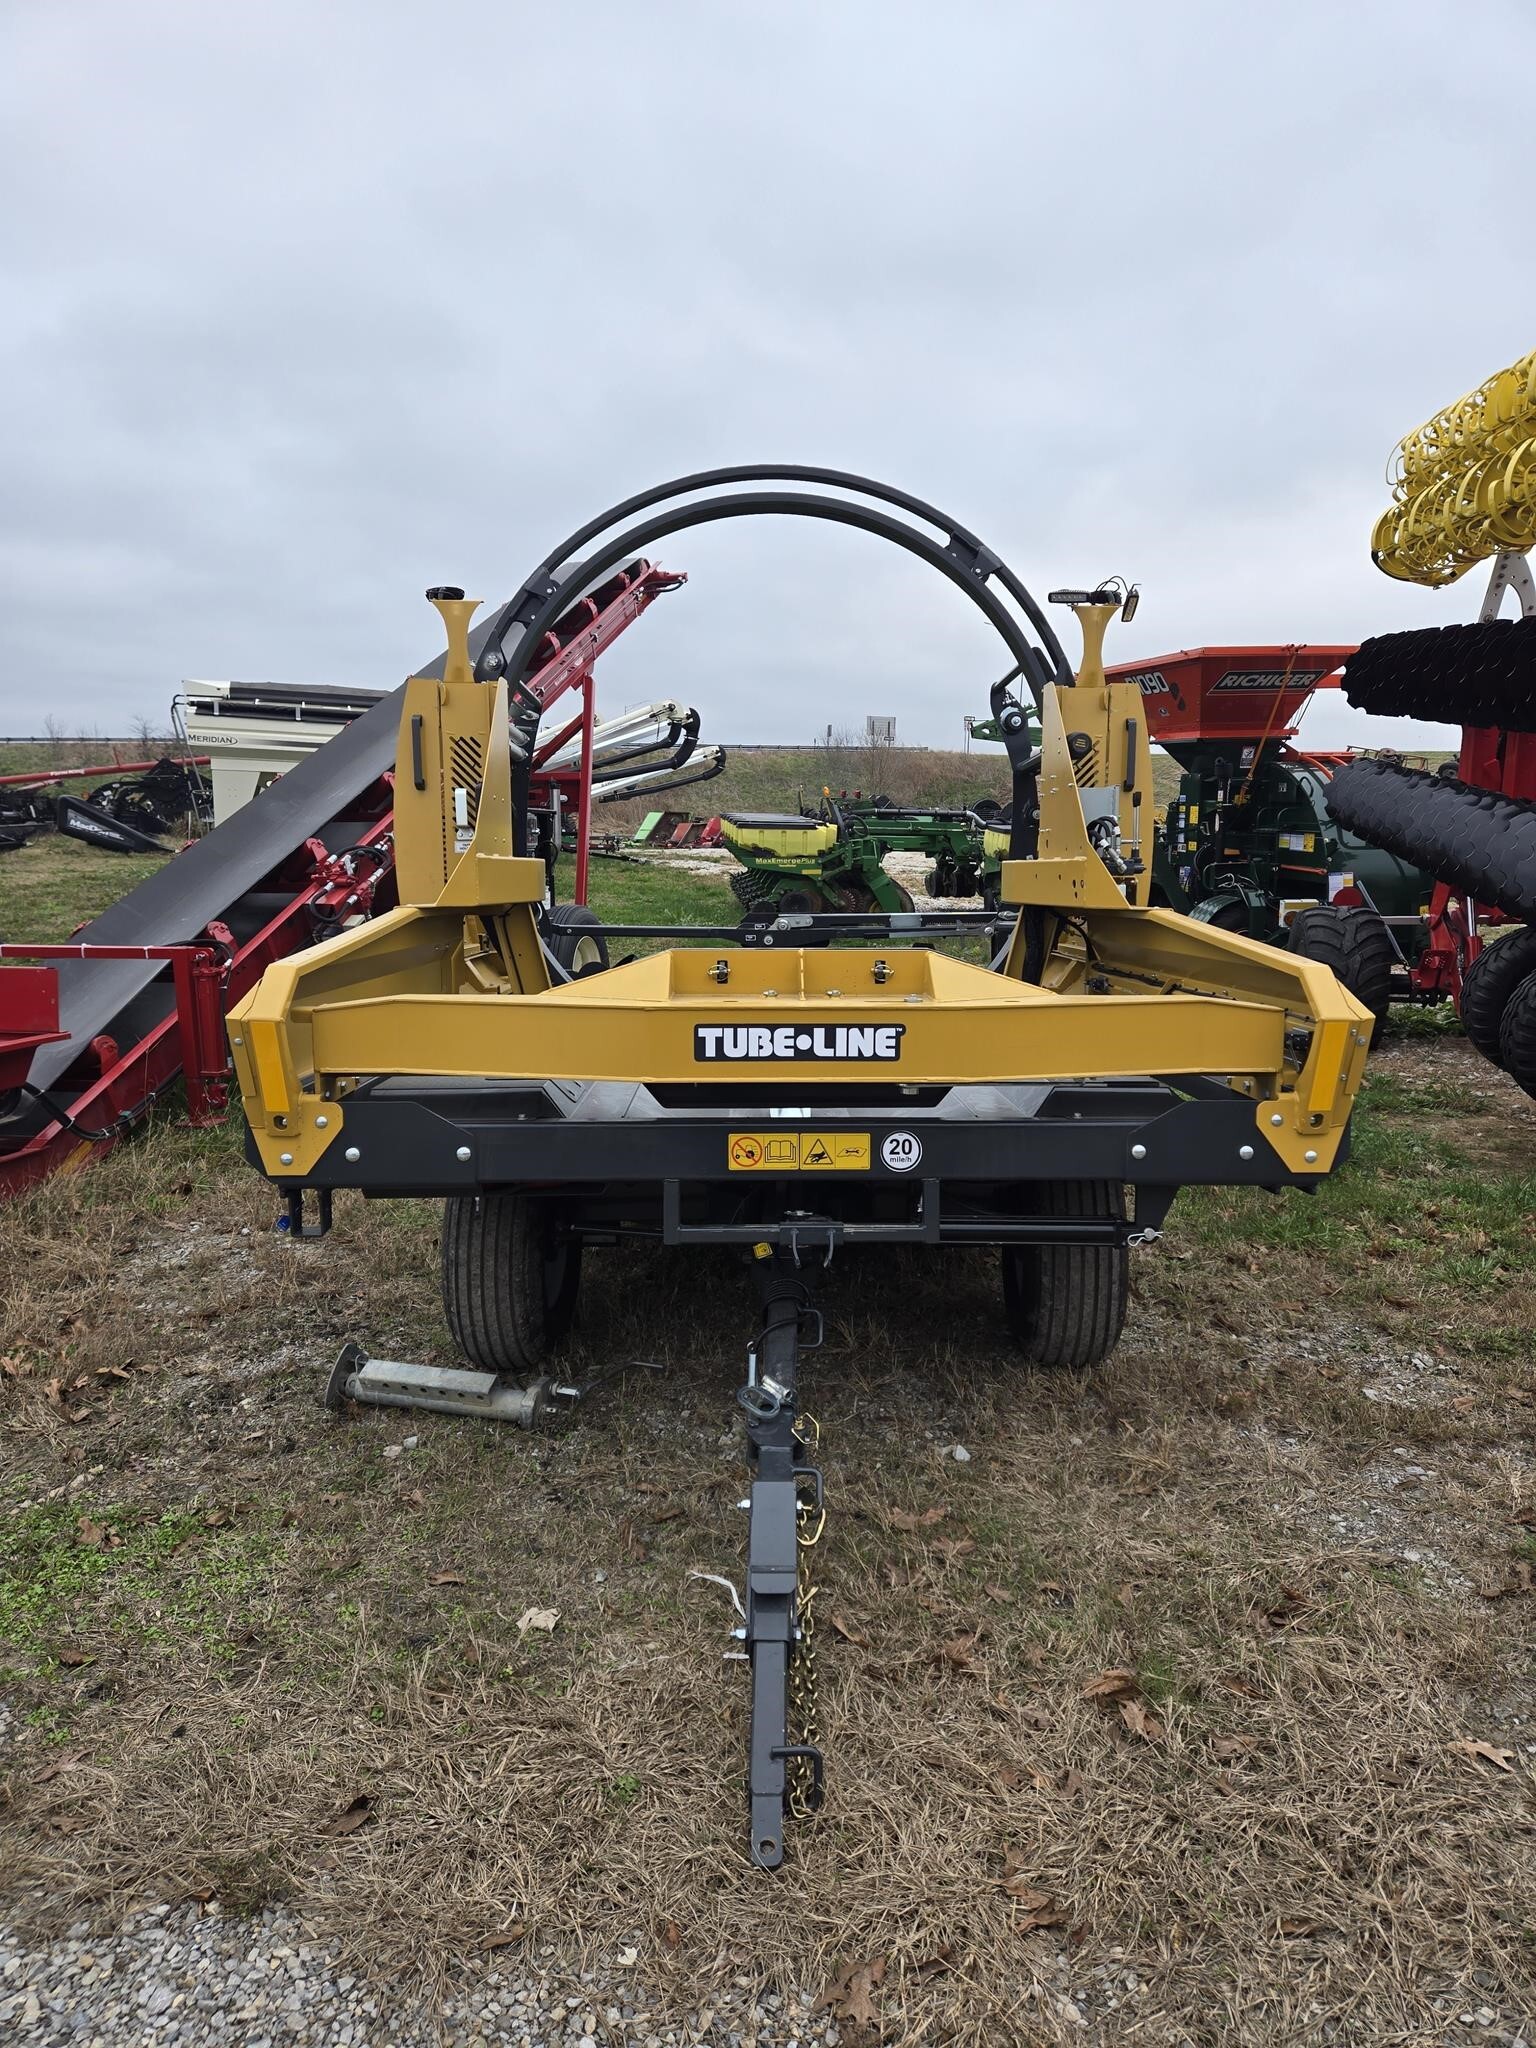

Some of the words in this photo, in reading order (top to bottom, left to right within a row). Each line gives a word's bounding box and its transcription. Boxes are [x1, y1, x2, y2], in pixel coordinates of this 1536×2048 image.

[1220, 674, 1316, 687] RICHIGER
[188, 734, 233, 744] MERIDIAN
[889, 1138, 912, 1156] 20
